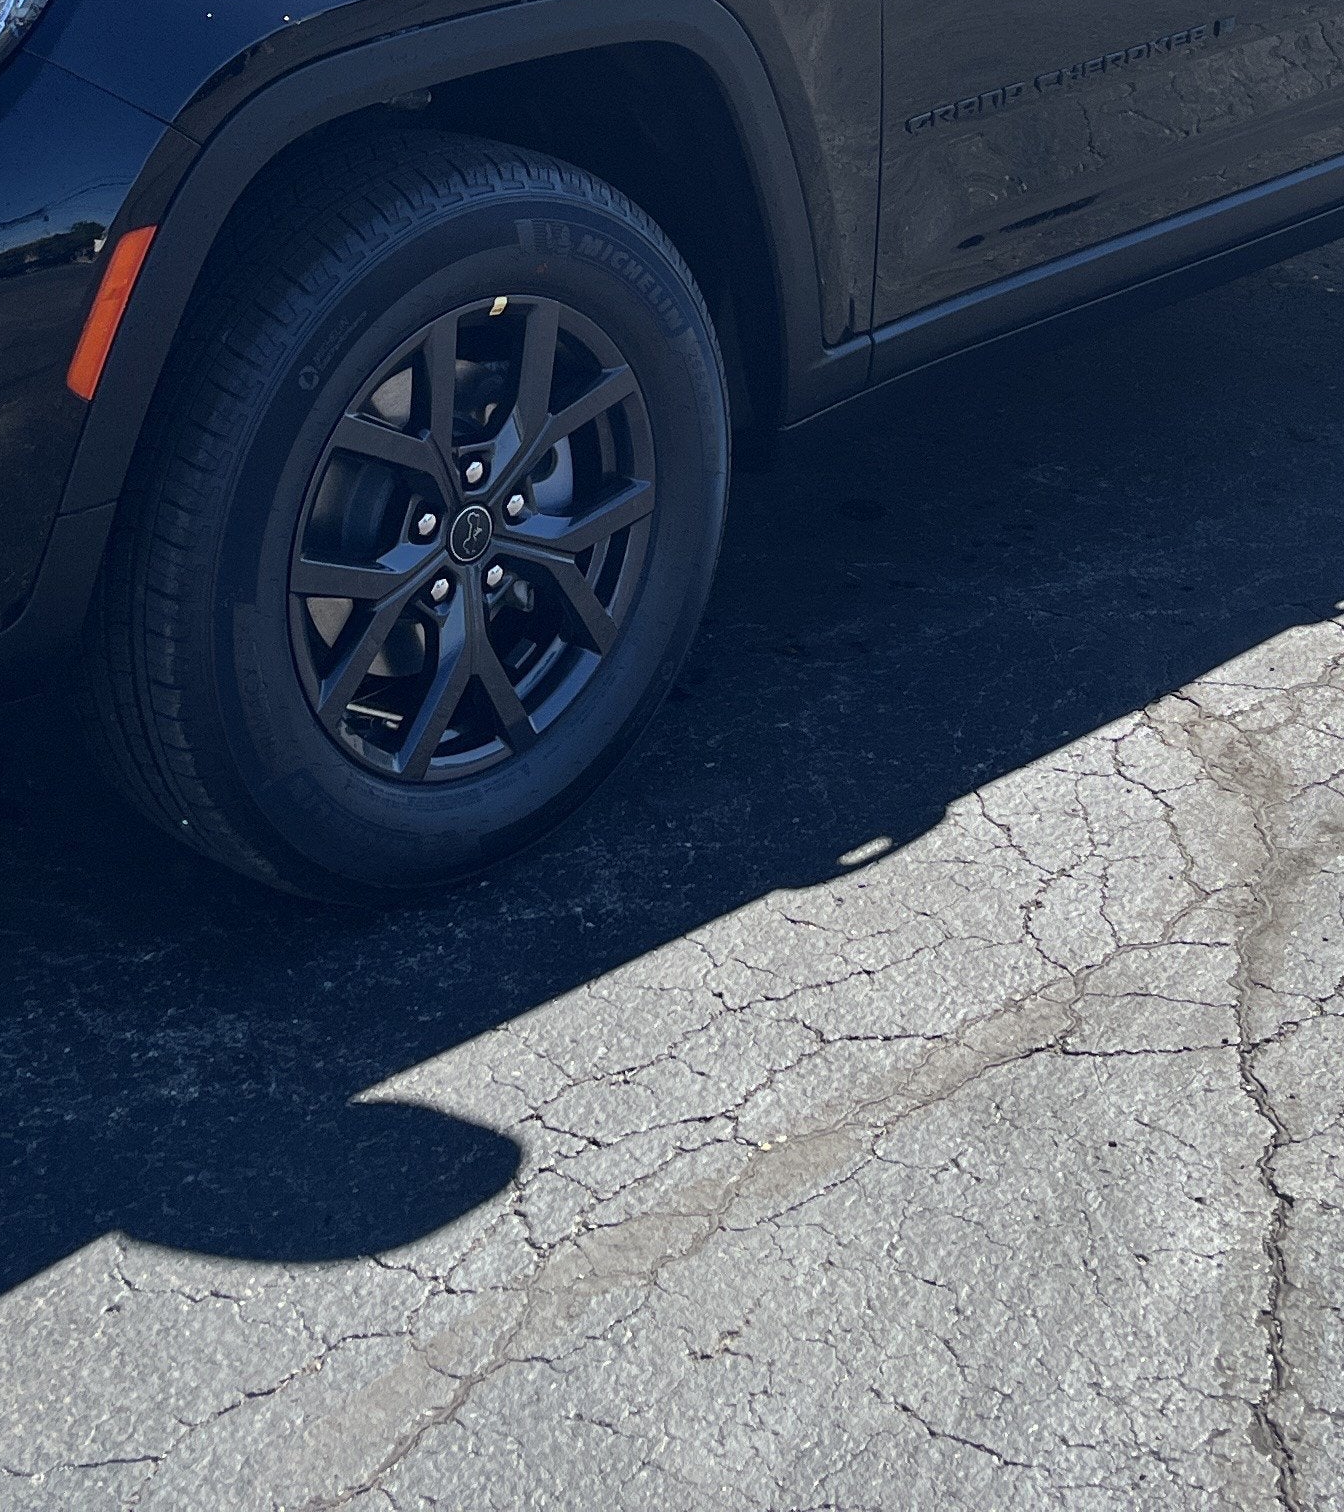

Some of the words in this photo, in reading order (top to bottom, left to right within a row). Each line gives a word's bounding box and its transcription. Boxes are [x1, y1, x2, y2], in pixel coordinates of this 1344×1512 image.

[904, 80, 1028, 136] GRAND
[1033, 23, 1209, 94] CHEROKEE
[579, 233, 686, 331] MICHELIN
